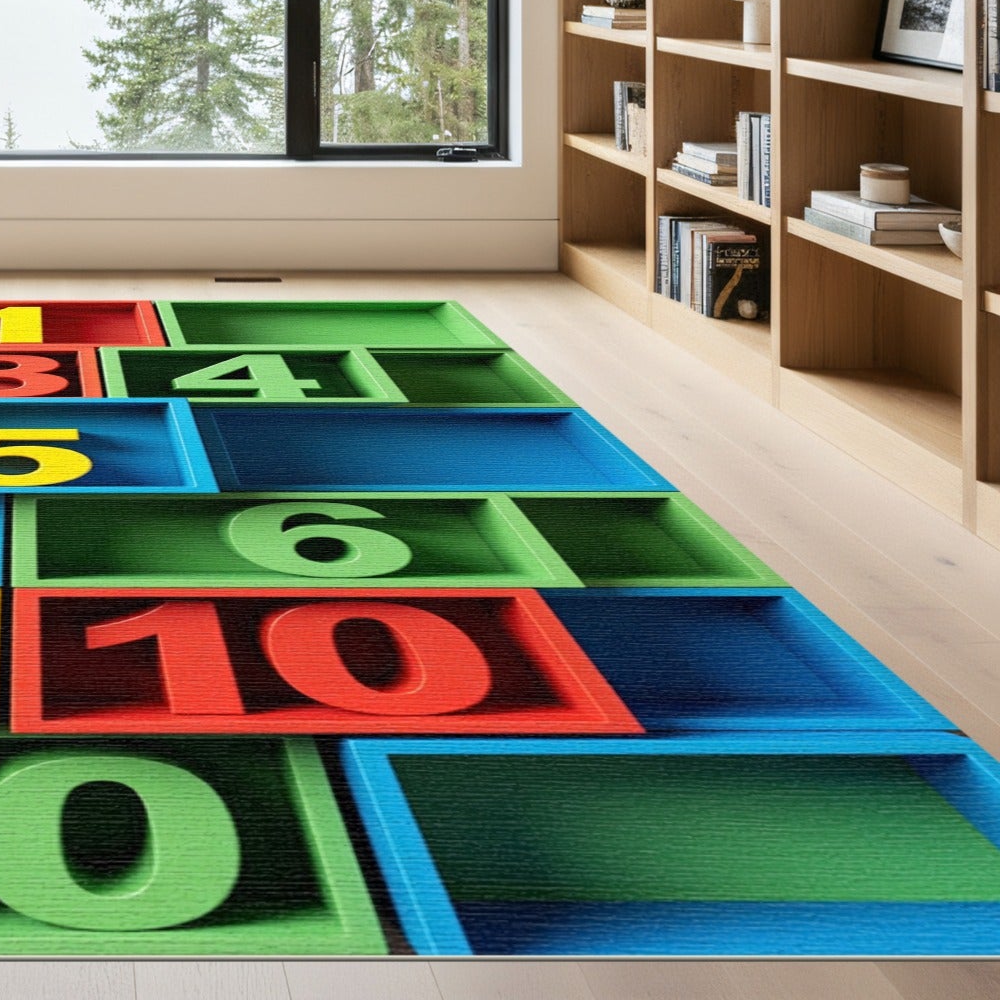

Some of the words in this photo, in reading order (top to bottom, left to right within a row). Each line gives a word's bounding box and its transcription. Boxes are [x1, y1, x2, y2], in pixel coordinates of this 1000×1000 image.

[172, 354, 320, 399] 4
[227, 502, 412, 578] 6
[85, 601, 493, 715] 10
